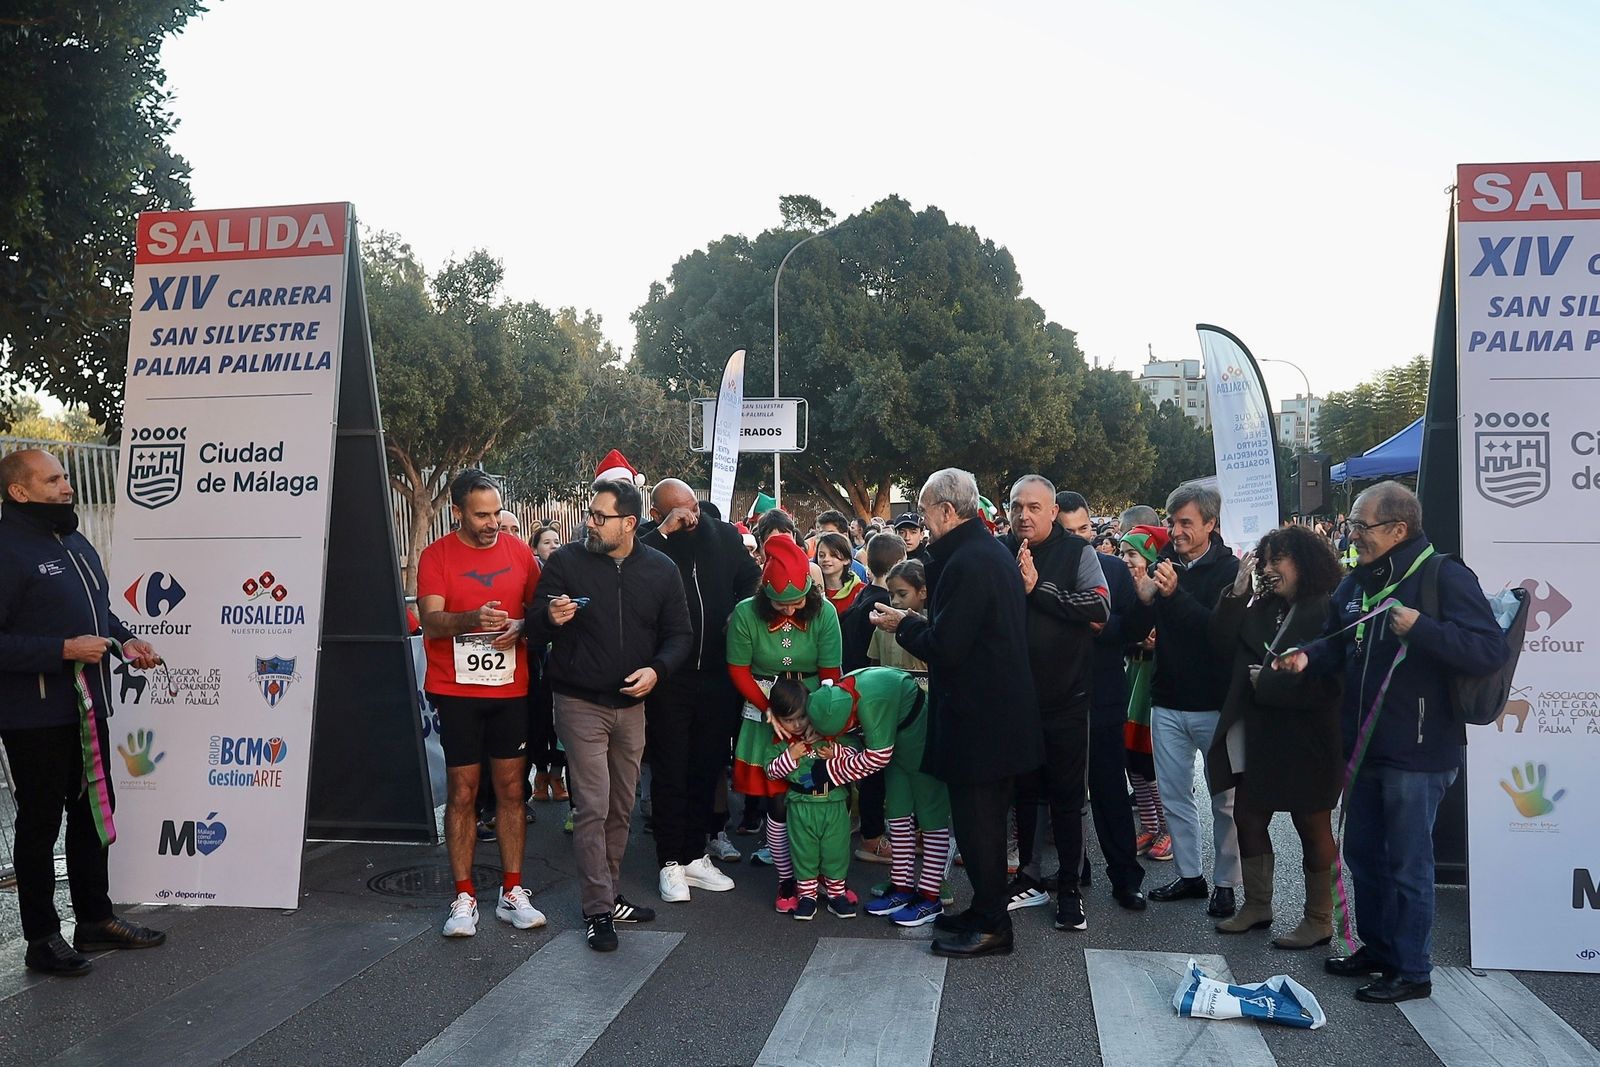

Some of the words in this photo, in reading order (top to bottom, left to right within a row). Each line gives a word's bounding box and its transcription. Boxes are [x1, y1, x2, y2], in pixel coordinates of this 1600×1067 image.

[147, 213, 334, 256] SALIDA
[1469, 235, 1575, 277] XIV
[140, 274, 220, 312] XIV
[227, 284, 332, 308] CARRERA
[1487, 295, 1551, 318] SAN
[150, 327, 198, 346] SAN
[203, 321, 320, 345] SILVESTRE
[1468, 330, 1574, 352] PALMA
[133, 355, 211, 376] PALMA
[217, 351, 331, 374] PALMILLA
[199, 441, 284, 463] Ciudad
[196, 472, 226, 493] de
[233, 470, 319, 497] Málaga
[220, 605, 305, 625] ROSALEDA
[467, 652, 506, 672] 962
[1551, 709, 1565, 717] LA
[1538, 725, 1572, 734] PALMA
[208, 735, 221, 766] GRUPO
[220, 737, 263, 766] BCM
[208, 768, 282, 788] GestionARTE
[175, 890, 216, 899] deporinter
